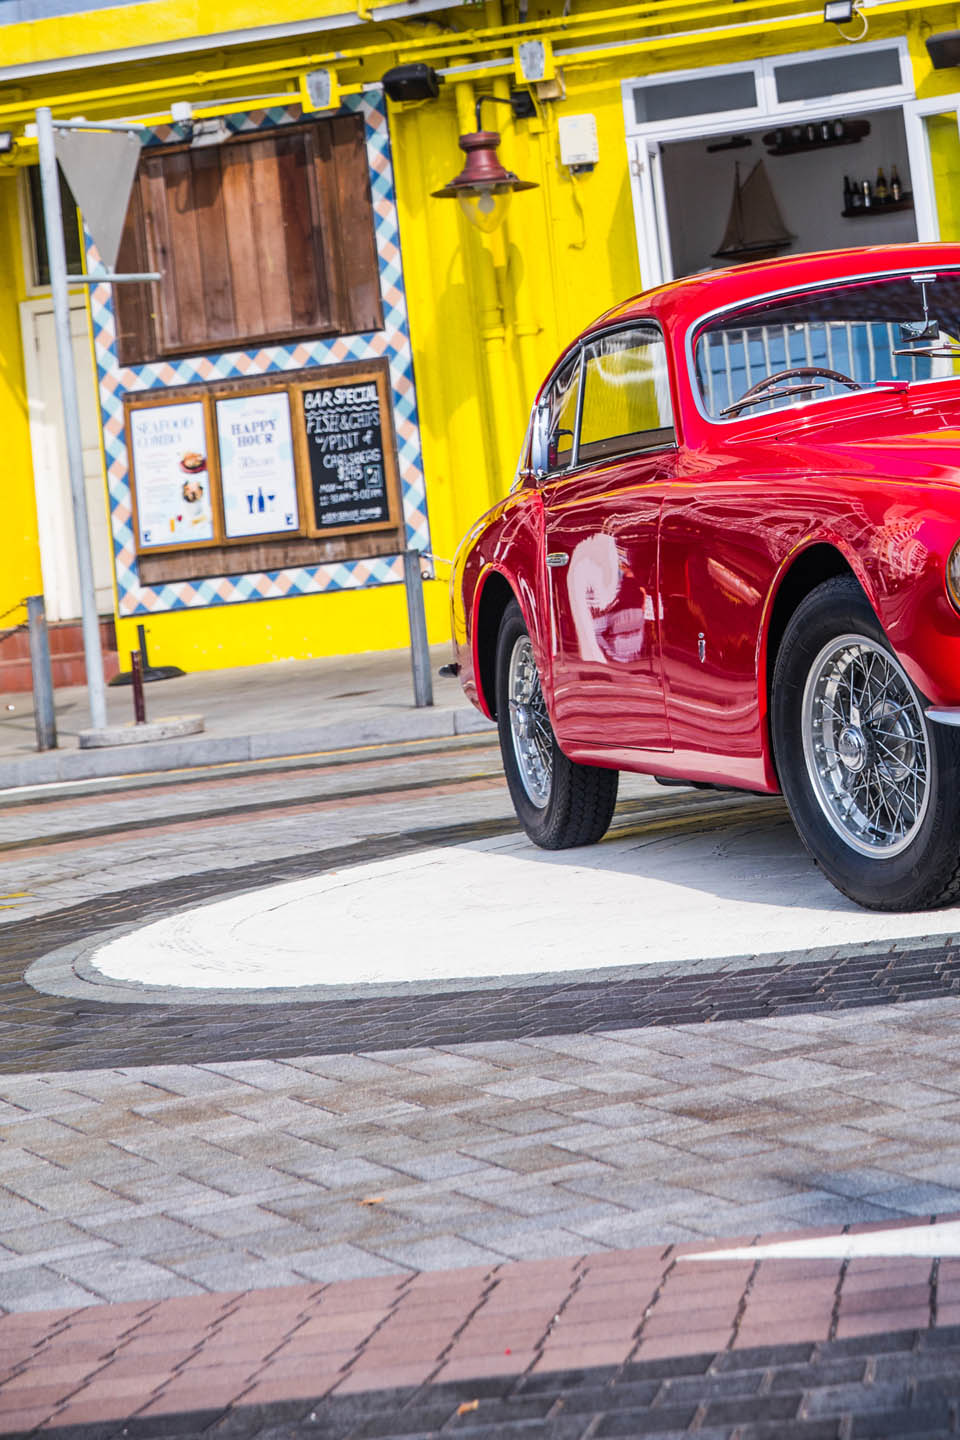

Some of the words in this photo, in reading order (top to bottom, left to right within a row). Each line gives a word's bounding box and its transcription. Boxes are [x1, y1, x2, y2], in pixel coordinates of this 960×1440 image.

[304, 390, 334, 409] BAR
[333, 384, 379, 405] SPECIAL
[231, 419, 277, 436] HAPPY
[237, 433, 273, 448] HOUR
